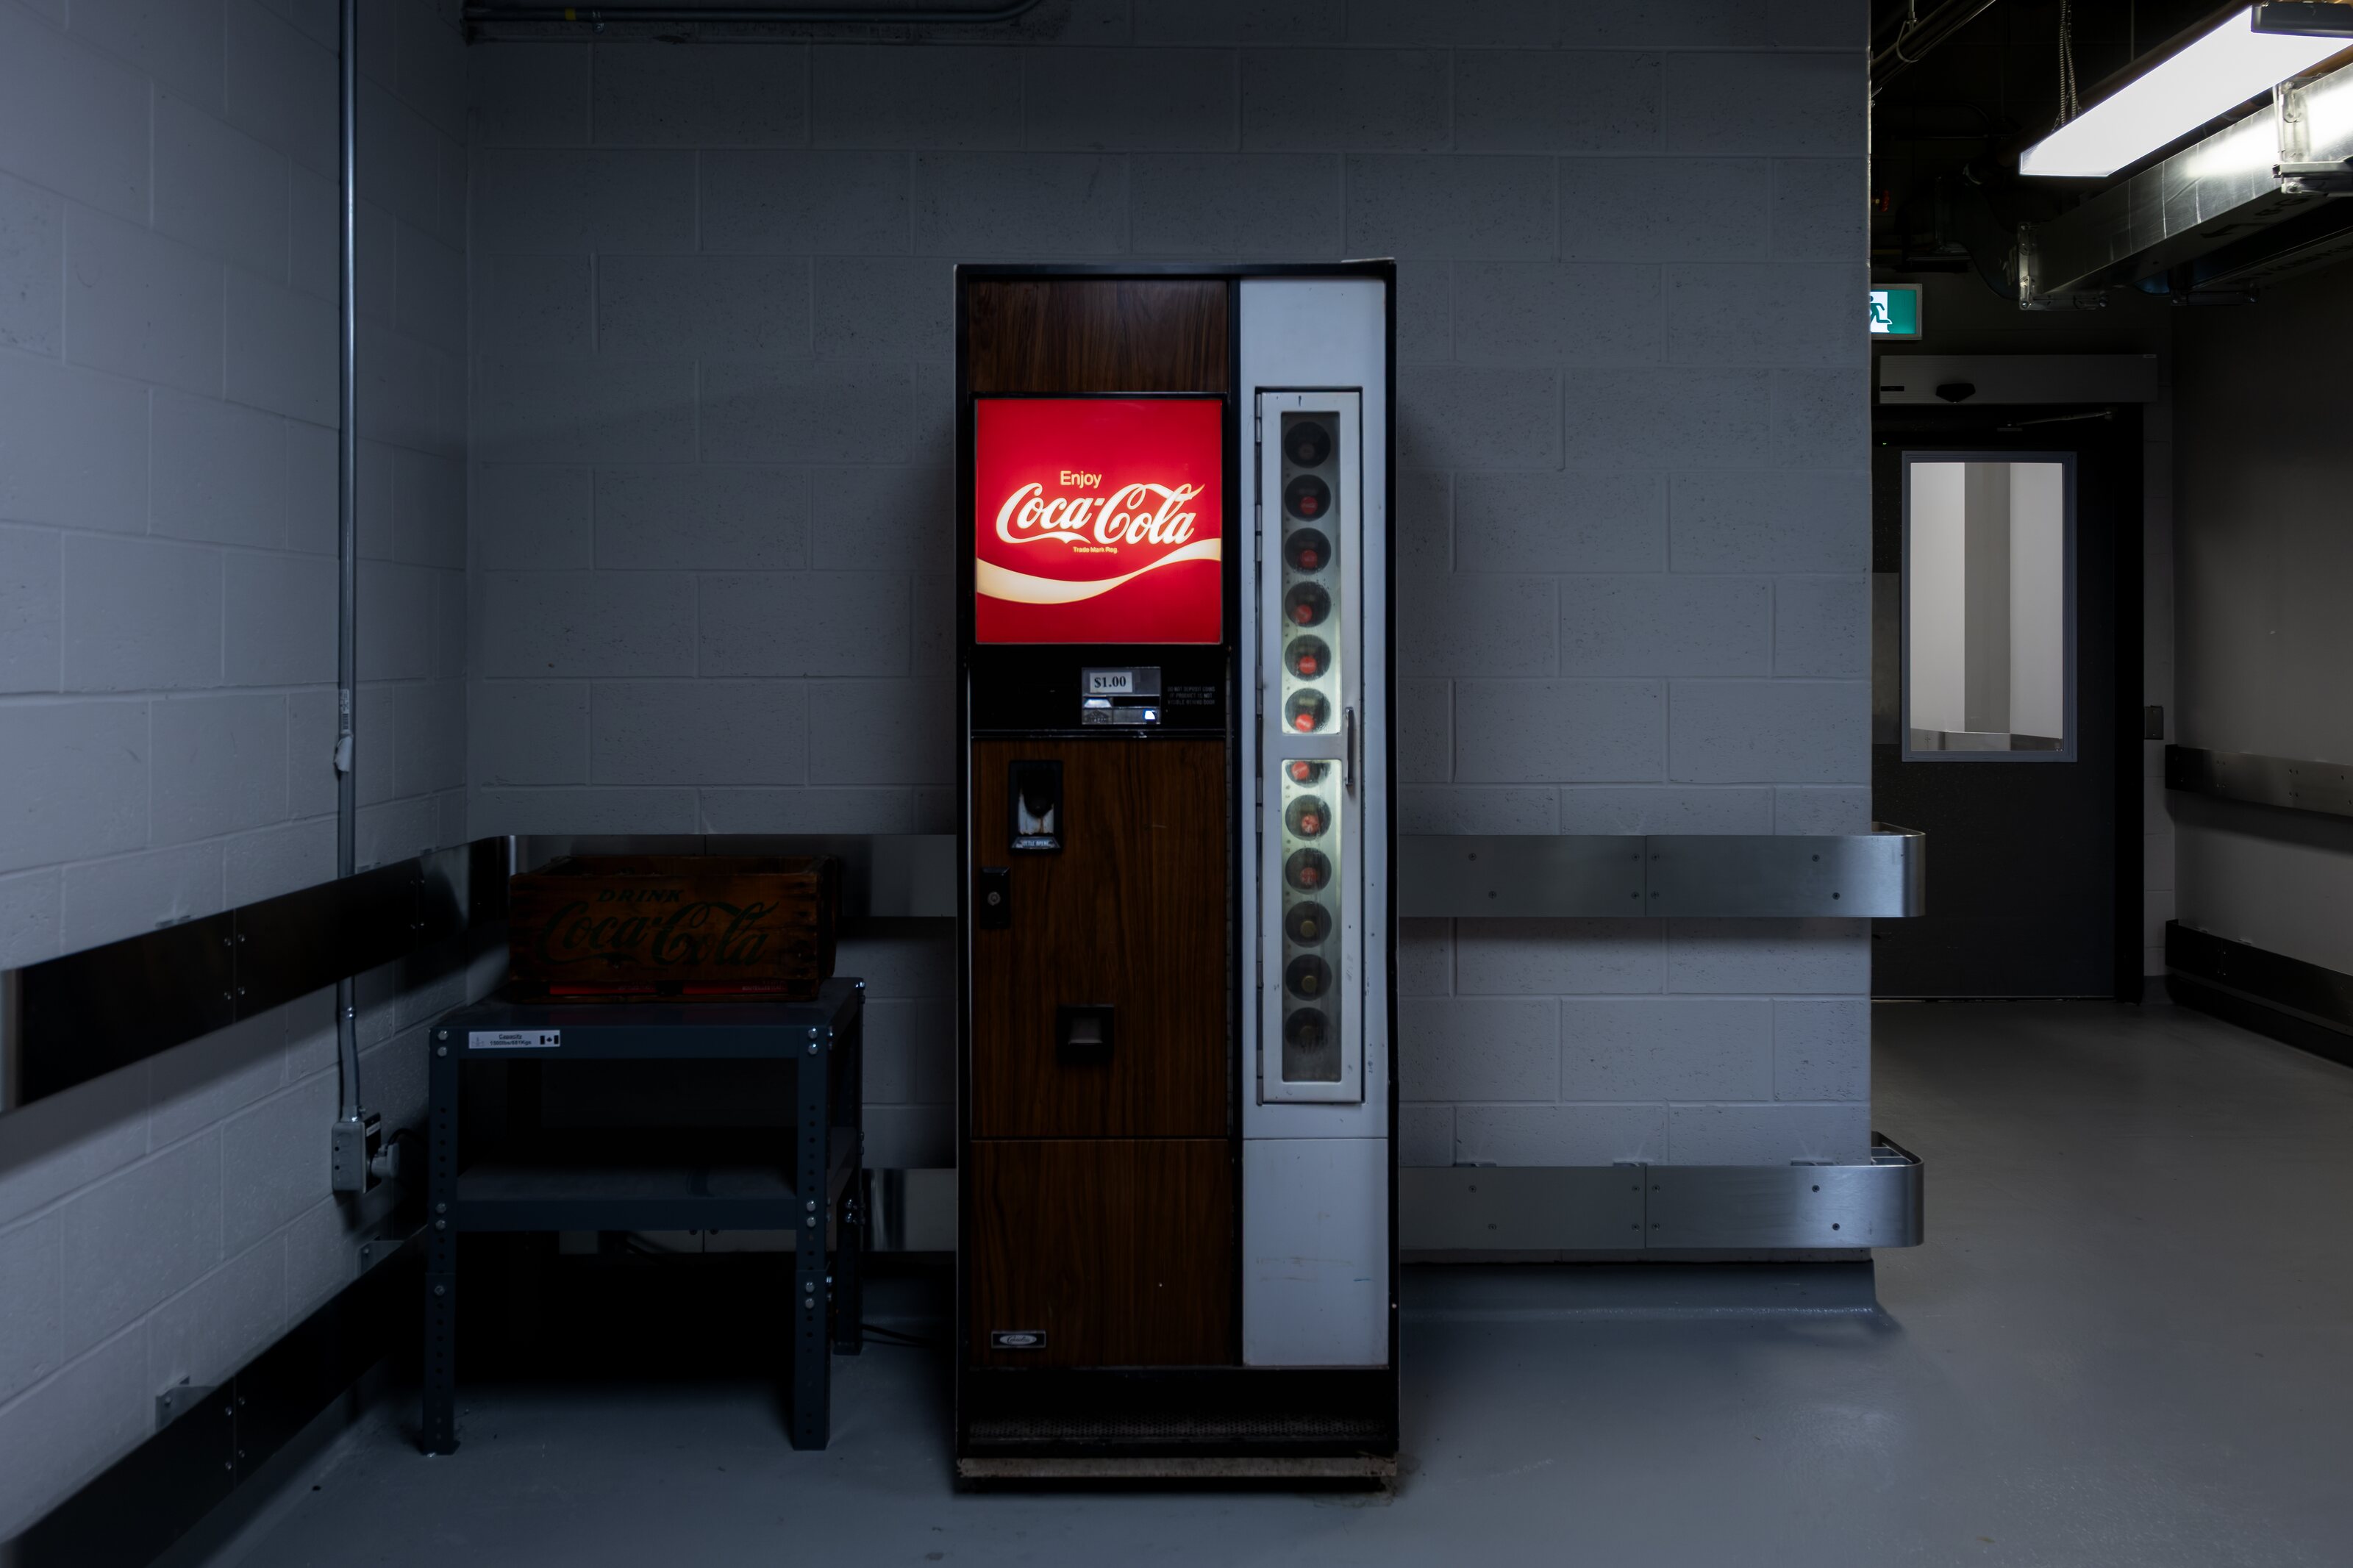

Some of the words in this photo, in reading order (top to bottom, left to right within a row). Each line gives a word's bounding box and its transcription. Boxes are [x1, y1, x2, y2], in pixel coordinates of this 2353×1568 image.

[1060, 470, 1102, 489] Enjoy
[996, 482, 1205, 545] Coca-Cola
[1093, 676, 1126, 689] $1.00
[597, 889, 684, 903] DRINK
[542, 901, 779, 966] Coca-Cola
